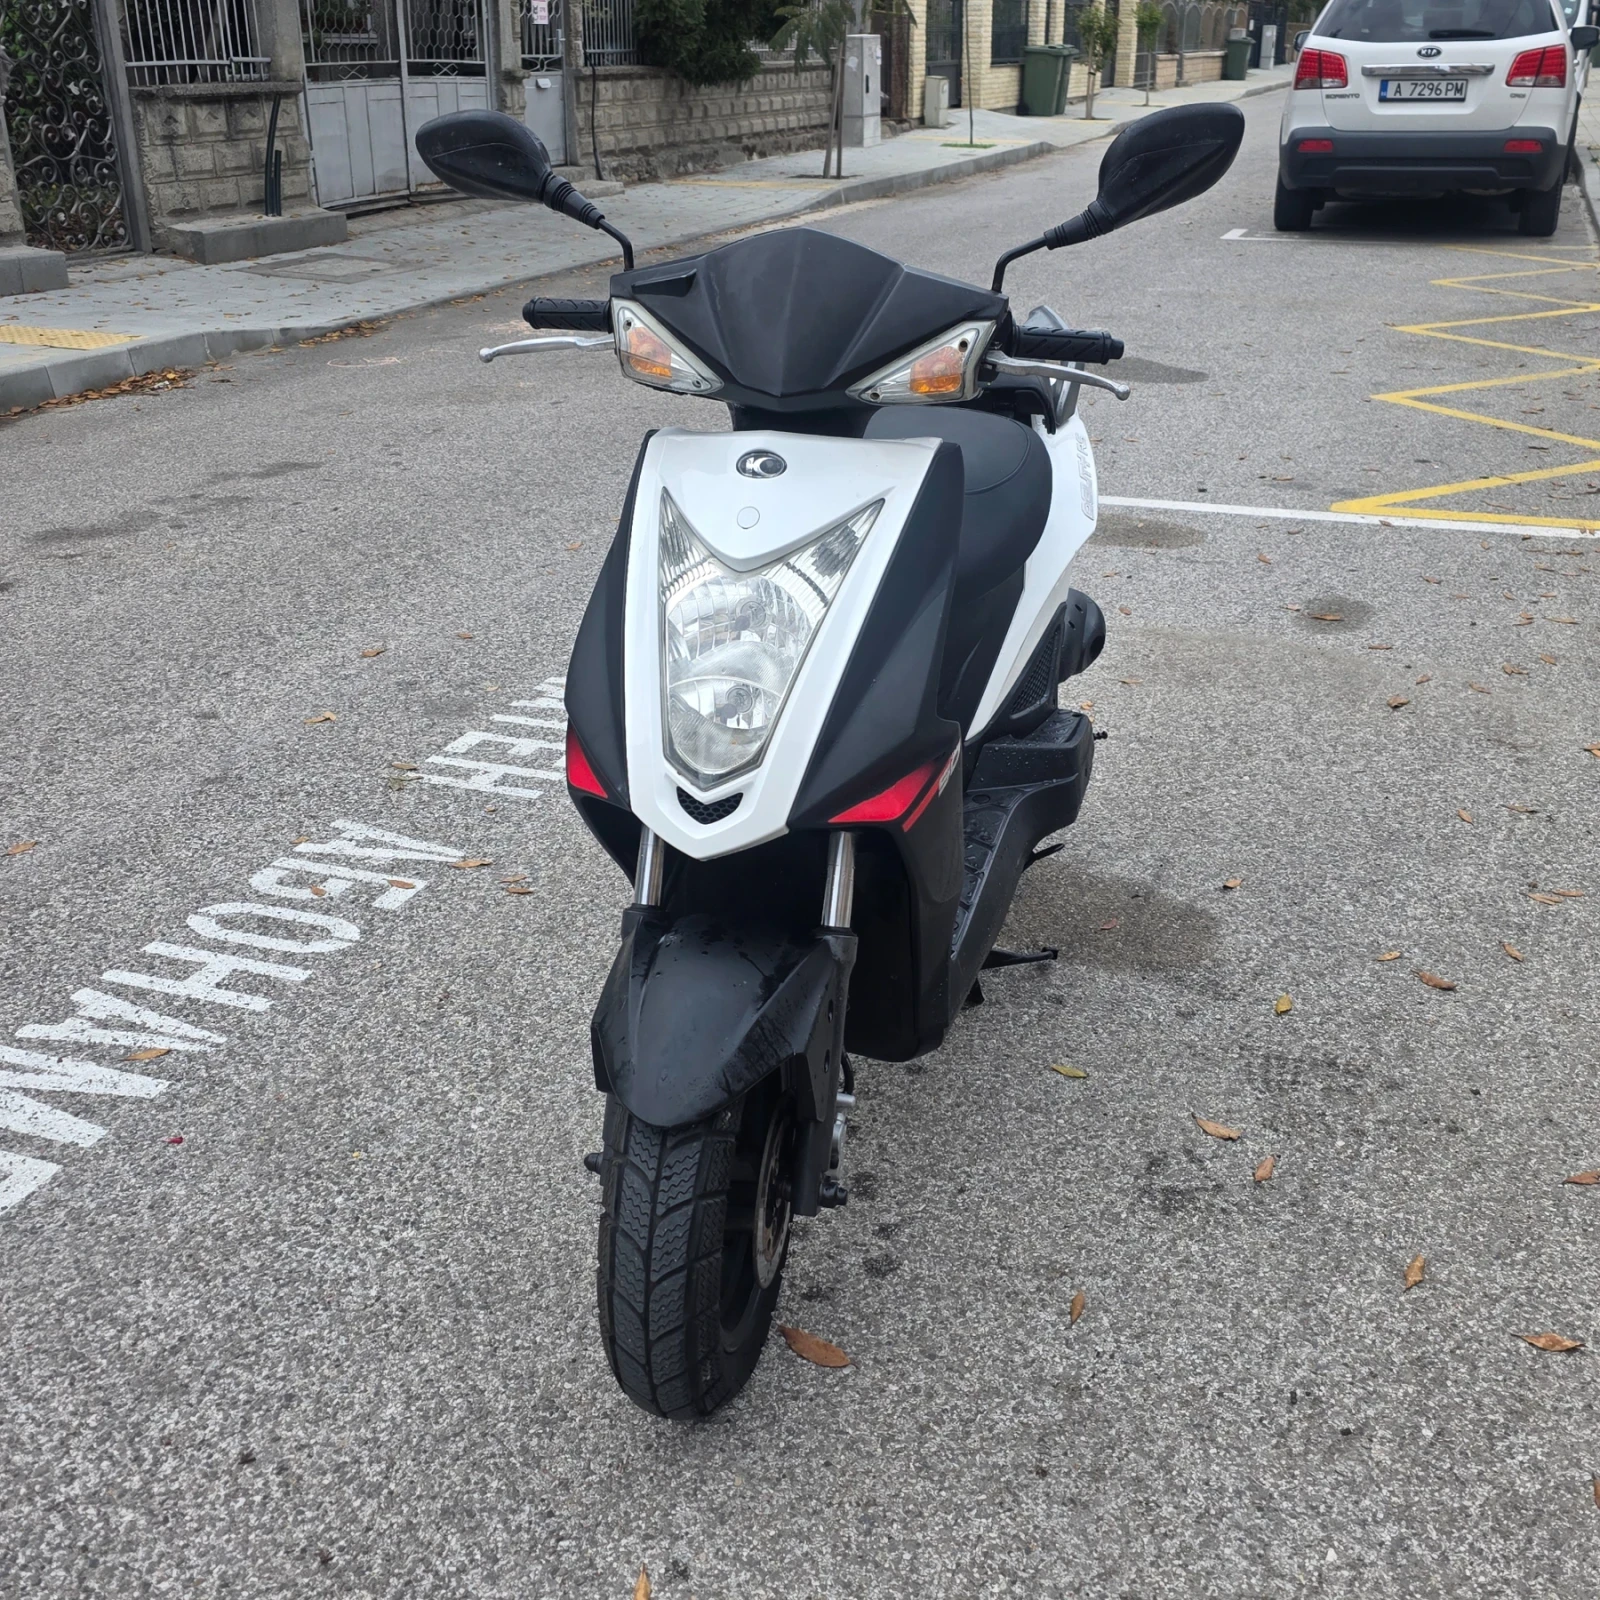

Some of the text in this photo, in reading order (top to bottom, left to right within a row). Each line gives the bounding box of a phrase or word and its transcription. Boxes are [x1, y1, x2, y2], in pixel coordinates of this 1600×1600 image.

[1420, 48, 1438, 56] KIA
[1393, 82, 1465, 97] A 7296 PM
